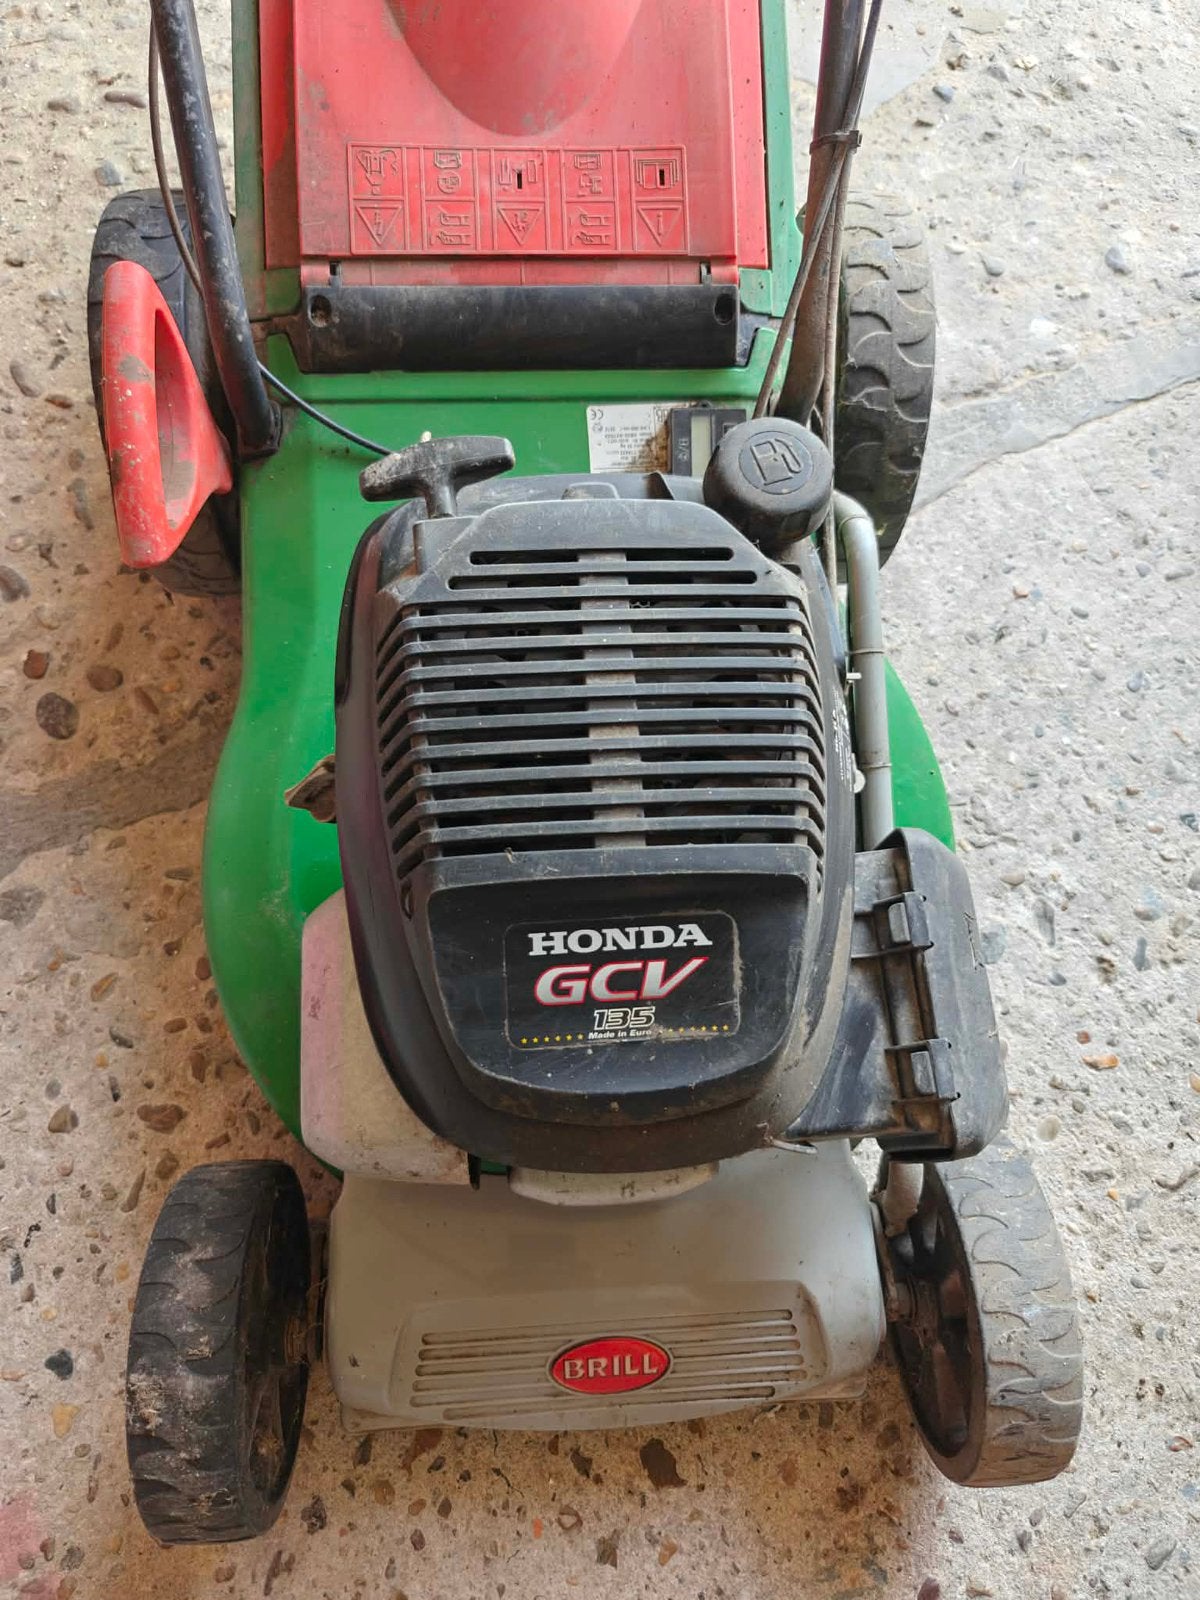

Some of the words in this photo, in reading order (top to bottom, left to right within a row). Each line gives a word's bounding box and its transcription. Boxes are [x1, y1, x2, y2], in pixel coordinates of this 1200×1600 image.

[528, 923, 713, 956] HONDA
[534, 956, 710, 1006] GCV
[593, 1006, 656, 1031] 135
[588, 1031, 615, 1040] Made
[617, 1030, 628, 1038] in
[629, 1029, 653, 1037] Euro
[564, 1353, 658, 1380] BRILL
